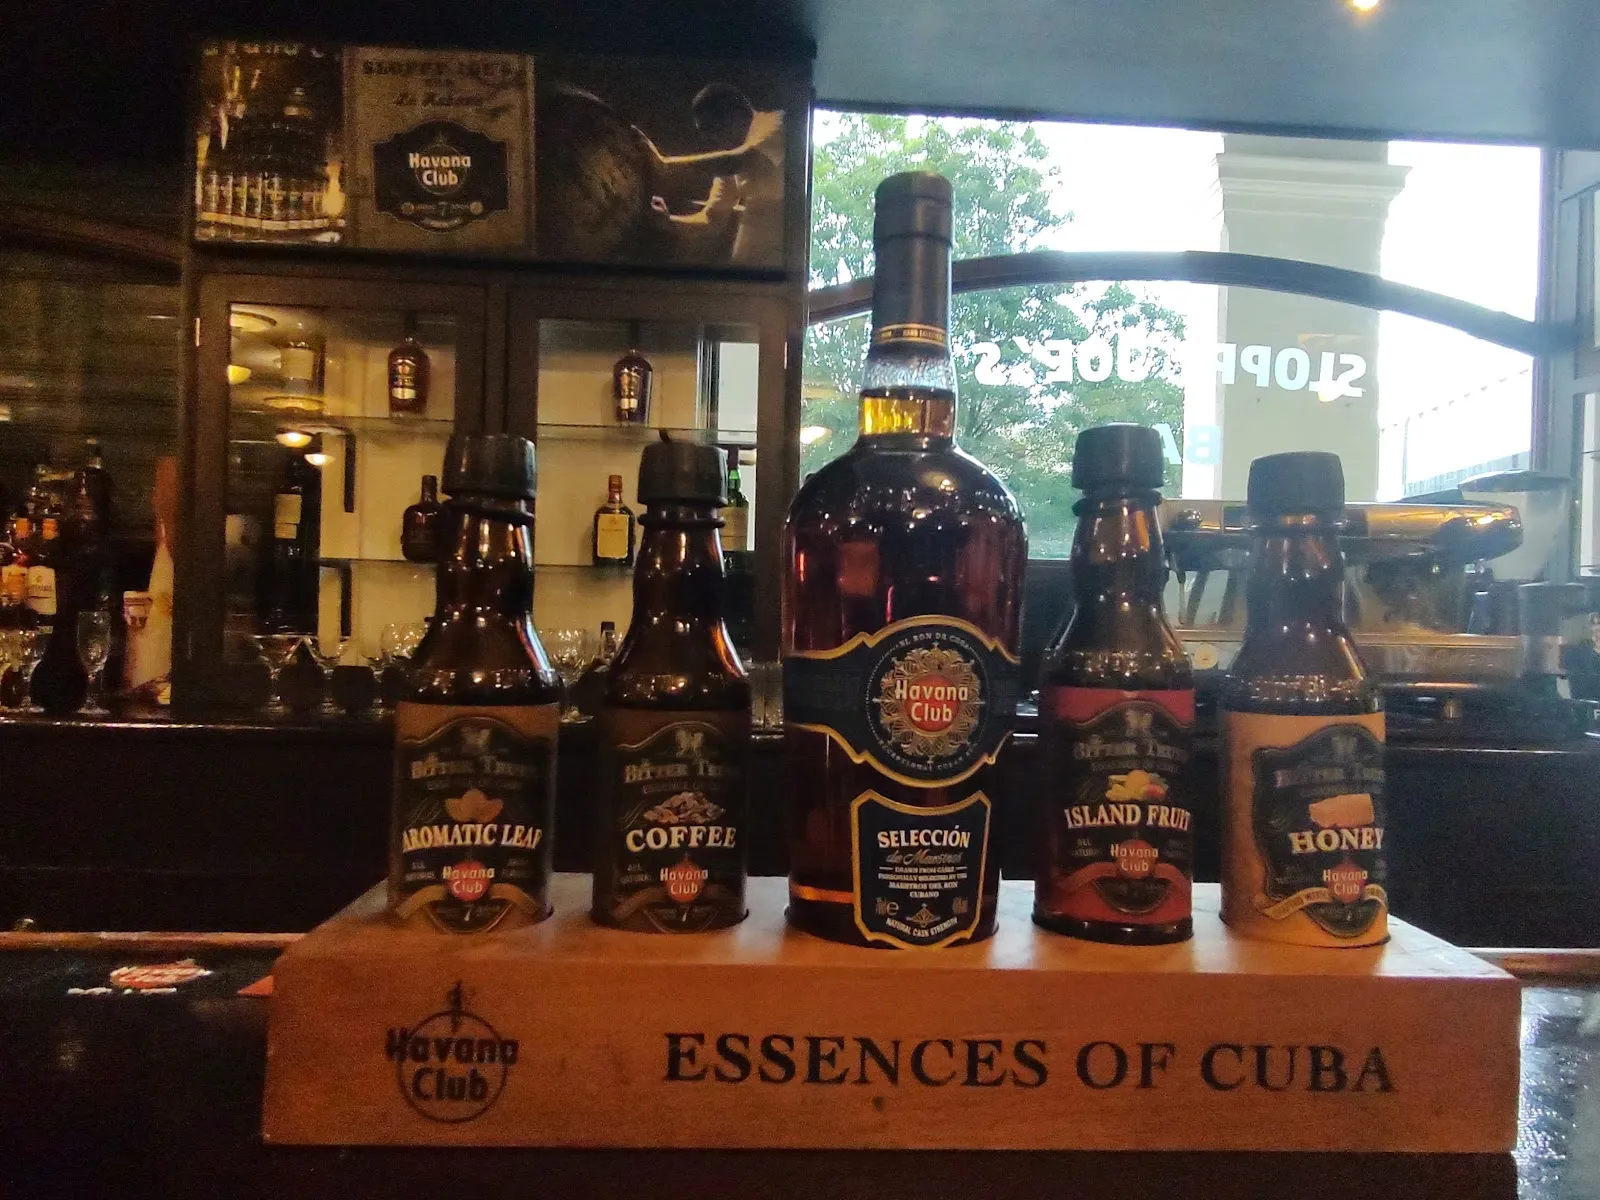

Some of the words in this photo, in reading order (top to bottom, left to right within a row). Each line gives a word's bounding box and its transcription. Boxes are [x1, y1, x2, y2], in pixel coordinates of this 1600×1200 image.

[408, 152, 472, 169] Havana
[422, 169, 459, 186] Club
[895, 679, 969, 701] Havana
[911, 702, 953, 722] Club
[1065, 803, 1142, 830] ISLAND
[1146, 803, 1193, 832] FRUIT
[402, 823, 496, 854] AROMATIC
[626, 825, 737, 853] COFFEE
[877, 825, 971, 849] SELECCIÓN
[1288, 827, 1385, 855] HONEY
[1110, 844, 1160, 859] Havana
[442, 866, 496, 880] Havana
[659, 867, 709, 882] Havana
[1121, 860, 1149, 872] Club
[1322, 869, 1369, 883] Havana
[452, 880, 483, 894] Club
[670, 882, 699, 895] Club
[888, 881, 928, 890] MAESTROS
[928, 882, 942, 890] DEL
[1333, 883, 1361, 896] Club
[909, 890, 940, 899] CUBANO
[885, 916, 912, 937] NATURAL
[912, 928, 930, 938] CASK
[386, 1028, 519, 1066] Havana
[665, 1031, 1049, 1087] ESSENCES
[1076, 1040, 1177, 1090] OF
[1200, 1044, 1397, 1094] CUBA
[412, 1068, 488, 1102] Club
